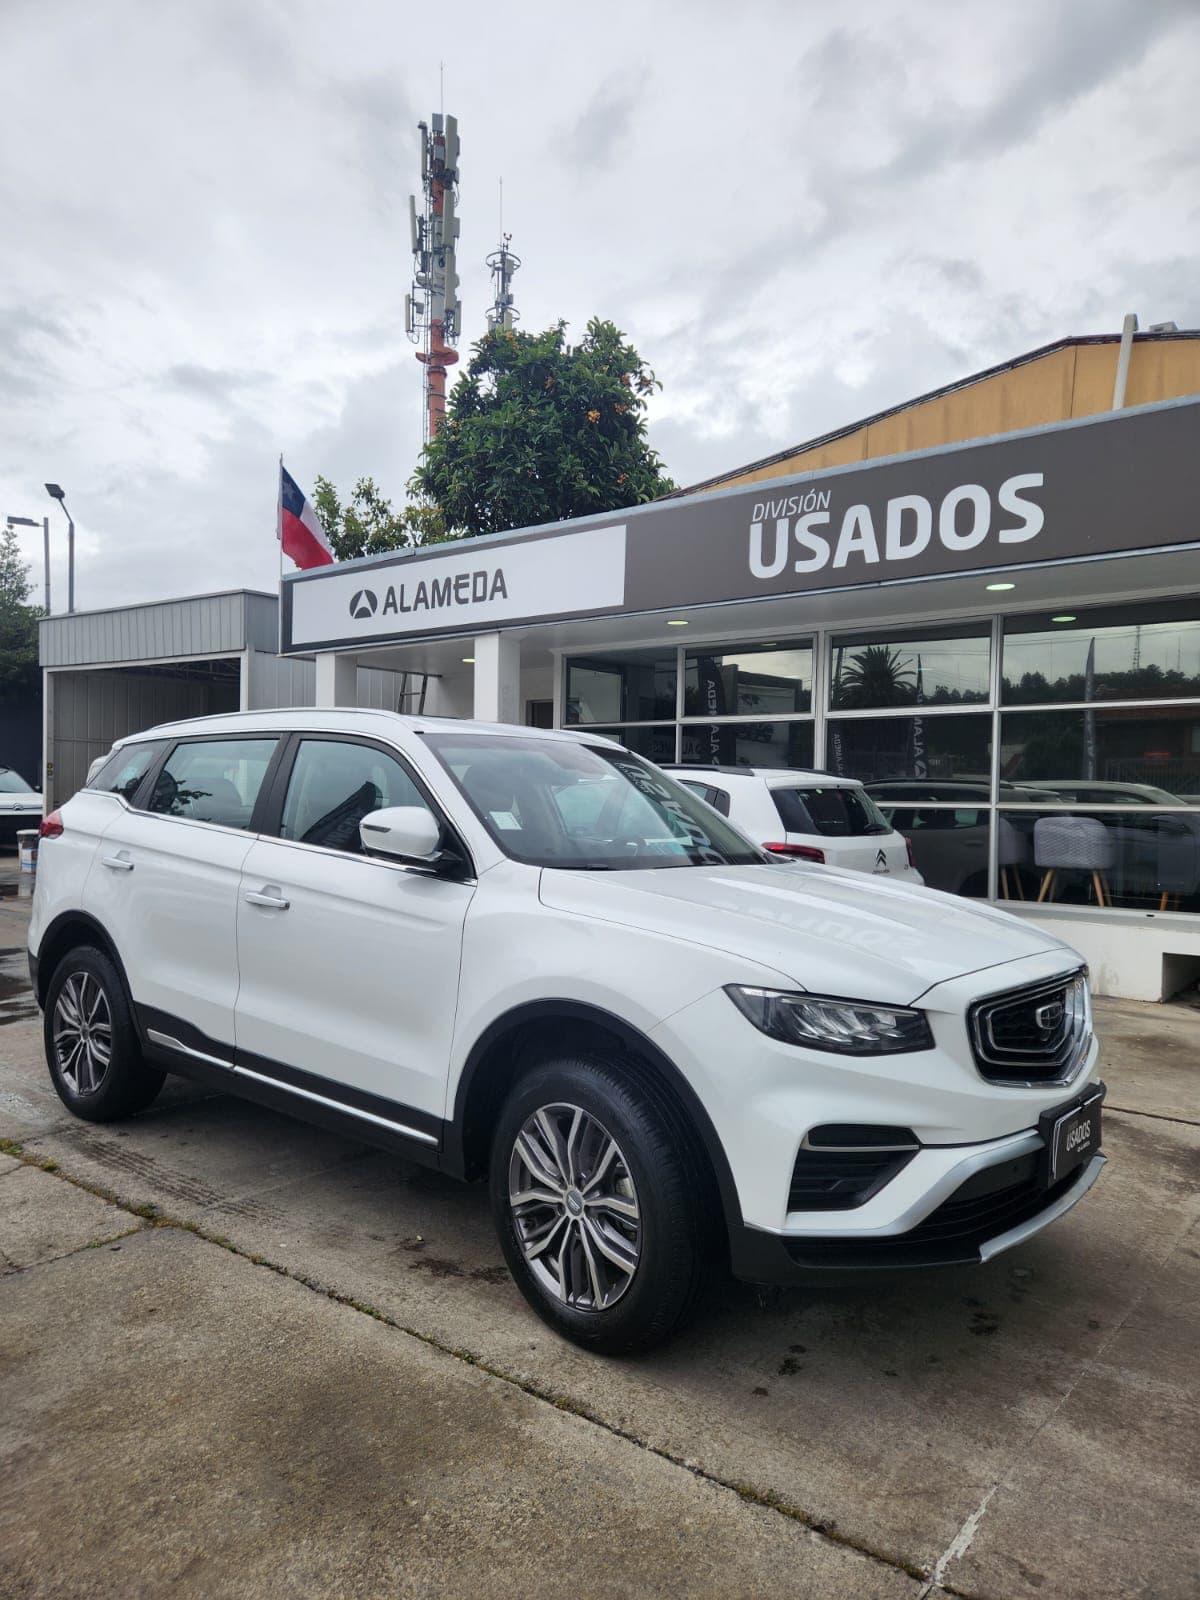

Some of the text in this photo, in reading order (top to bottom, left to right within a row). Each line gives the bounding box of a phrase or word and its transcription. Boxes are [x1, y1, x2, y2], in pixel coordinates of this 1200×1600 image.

[752, 488, 831, 522] DIVISIÓN
[748, 472, 1045, 579] USADOS
[383, 568, 508, 615] ALAMEDA
[1066, 1119, 1091, 1152] USADOS
